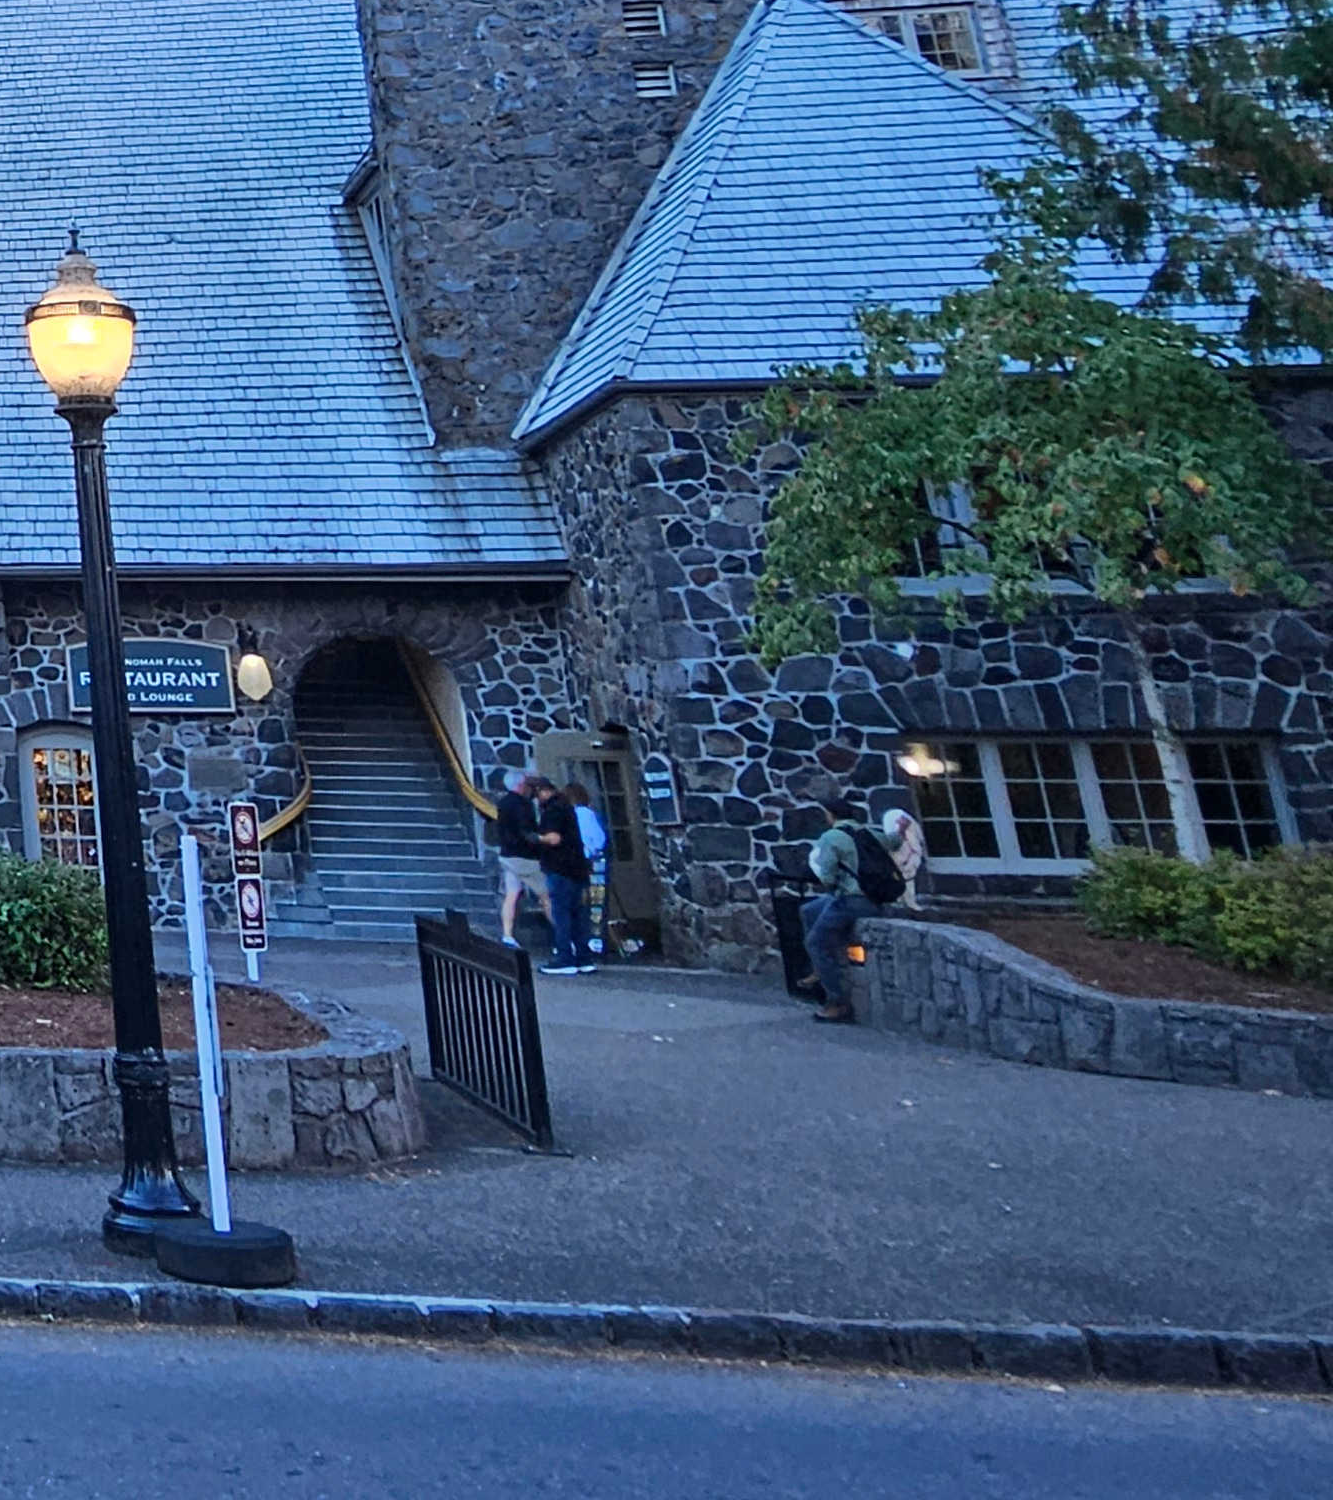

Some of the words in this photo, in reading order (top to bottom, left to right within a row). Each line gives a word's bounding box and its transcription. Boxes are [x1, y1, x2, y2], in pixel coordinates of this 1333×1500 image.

[167, 657, 203, 667] FALLS
[79, 671, 221, 687] RTAURANT
[140, 692, 194, 702] LOUNGE
